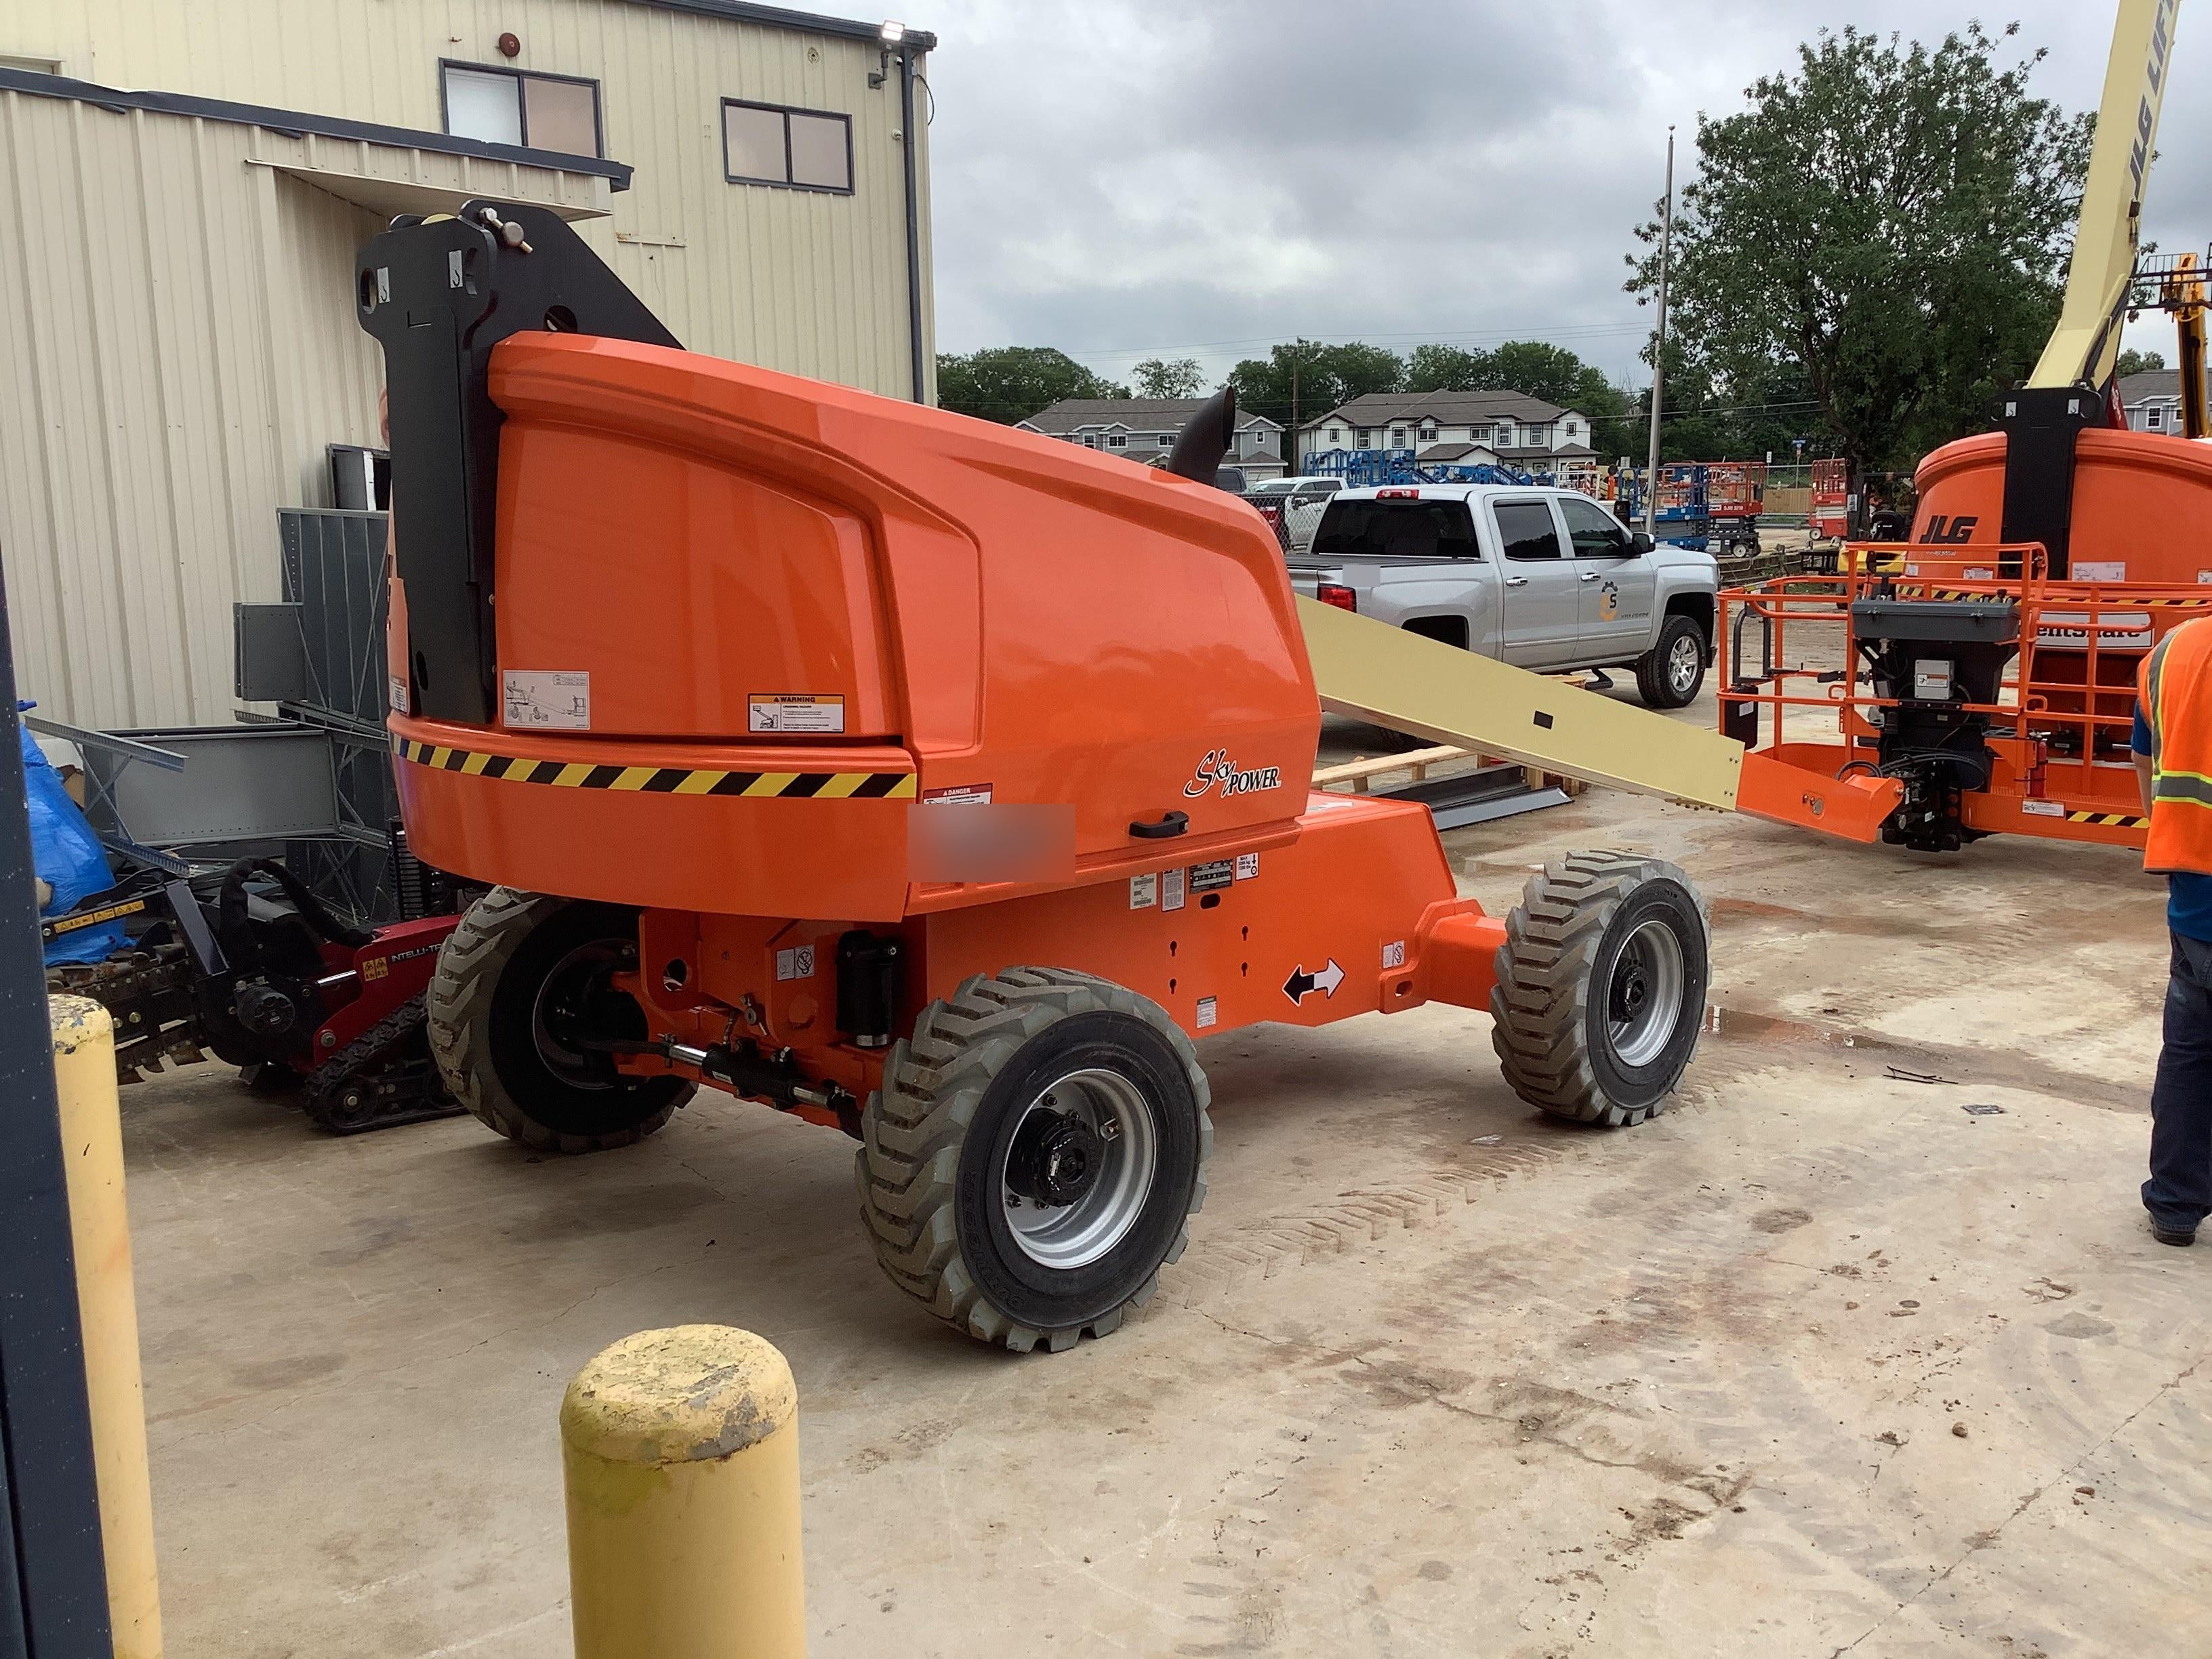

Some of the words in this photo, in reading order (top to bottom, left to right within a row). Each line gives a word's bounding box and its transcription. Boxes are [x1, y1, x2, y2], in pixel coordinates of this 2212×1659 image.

[2129, 92, 2153, 201] JLG
[1919, 515, 1979, 544] JLG
[947, 787, 971, 796] DANGER
